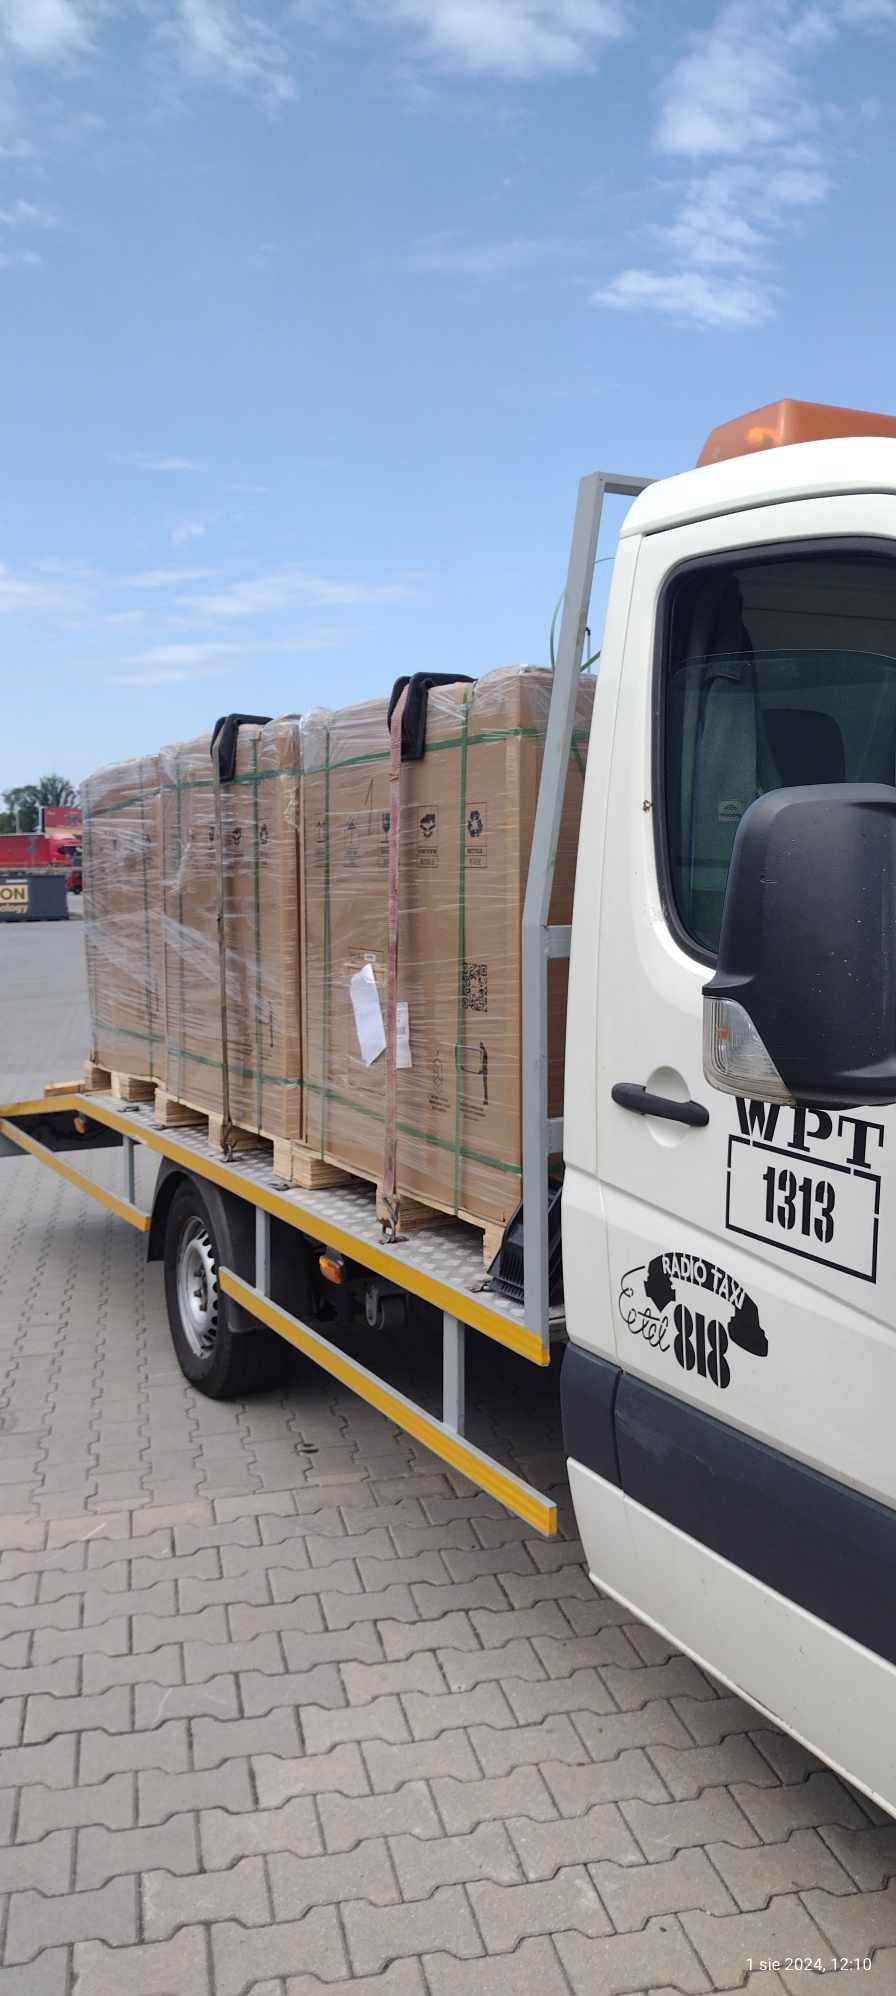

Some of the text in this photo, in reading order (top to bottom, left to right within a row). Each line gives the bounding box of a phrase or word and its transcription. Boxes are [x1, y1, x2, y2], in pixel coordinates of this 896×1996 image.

[735, 1097, 885, 1169] WPT
[763, 1166, 836, 1244] 1313
[662, 1254, 745, 1309] RADIO TAXI
[673, 1304, 731, 1389] 818
